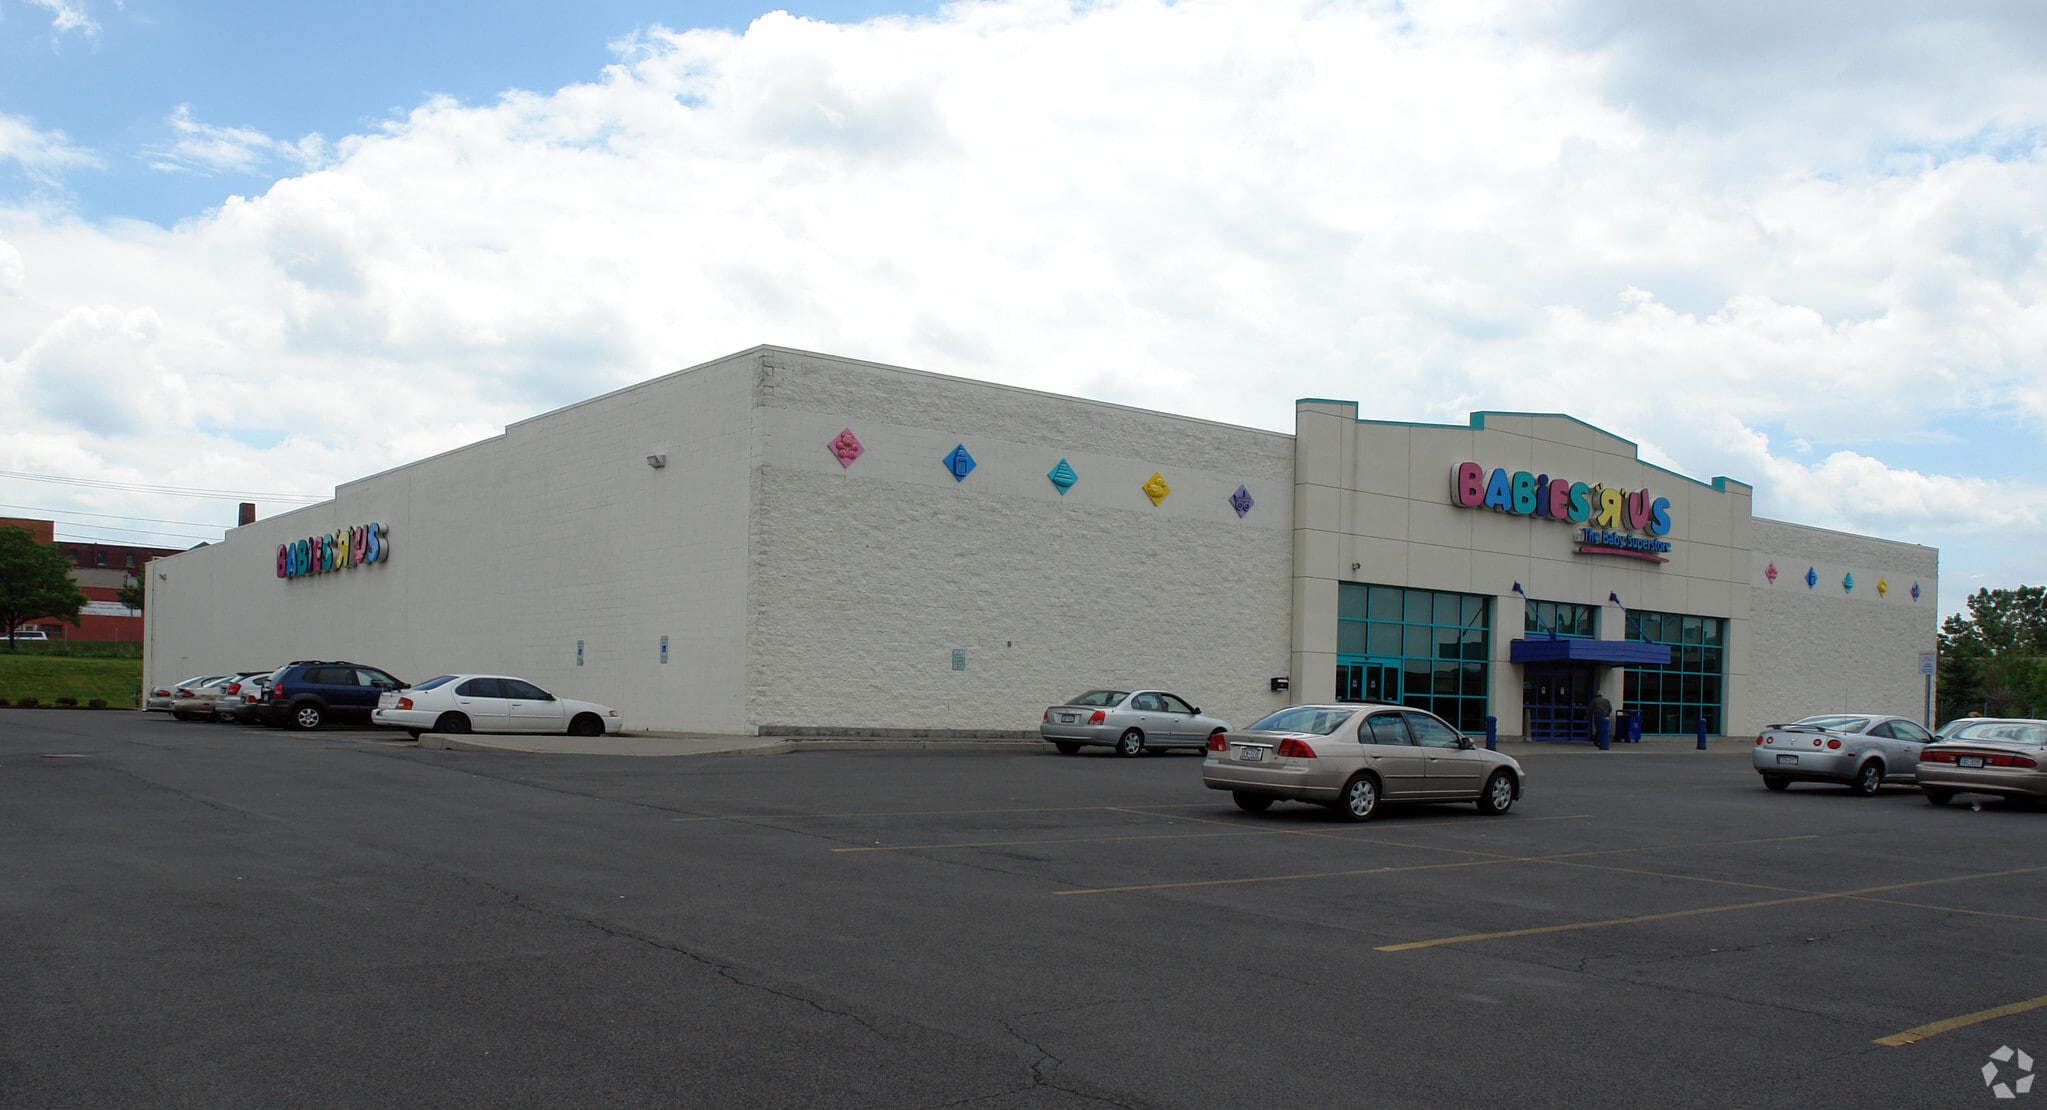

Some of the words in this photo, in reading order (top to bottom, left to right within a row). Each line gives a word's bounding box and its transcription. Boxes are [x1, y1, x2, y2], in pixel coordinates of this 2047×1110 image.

[1628, 487, 1672, 536] US
[353, 521, 381, 564] US
[1583, 527, 1601, 543] The
[1602, 530, 1626, 548] Baby
[1626, 533, 1672, 554] Superstore
